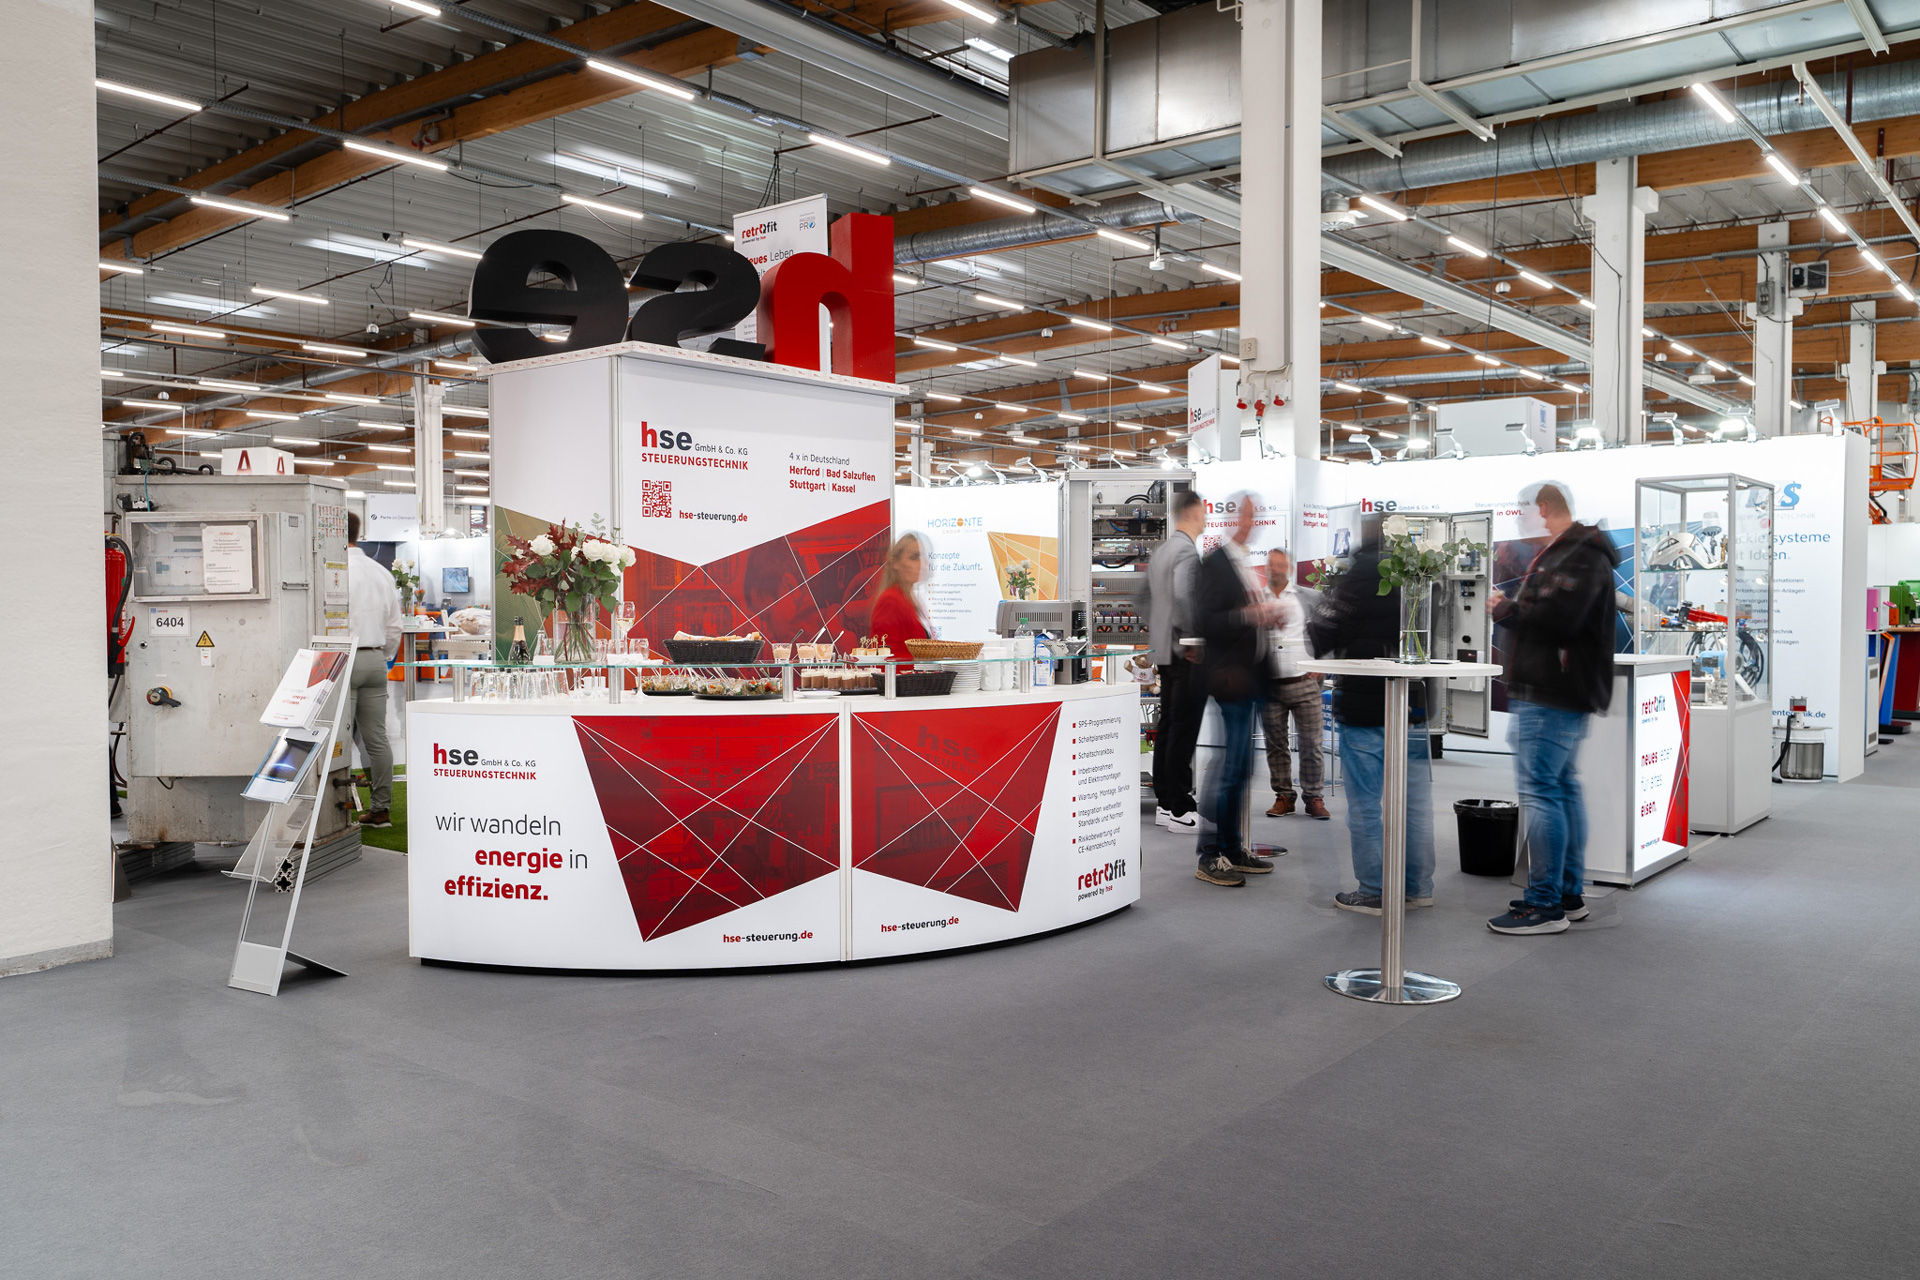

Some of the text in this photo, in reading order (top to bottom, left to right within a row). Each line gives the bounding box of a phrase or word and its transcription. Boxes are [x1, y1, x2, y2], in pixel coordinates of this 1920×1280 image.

[641, 421, 748, 456] hse GmbH & Co. KG
[641, 453, 749, 471] STEUERUNGSTECHNIK
[789, 452, 794, 460] 4
[802, 453, 809, 462] in
[811, 454, 850, 466] Deutschland
[789, 465, 876, 482] Herford Bad Salzuflen
[789, 479, 856, 493] Stuttgart Kassel
[1203, 499, 1237, 514] hse
[1362, 498, 1397, 512] hse
[679, 510, 748, 523] hse-steuerung.de
[928, 552, 960, 560] Konzepte
[928, 562, 983, 571] für die Zukunft.
[156, 617, 184, 627] 6404
[1078, 716, 1122, 728] SPS-Programmierung
[917, 725, 980, 764] hse
[433, 743, 479, 766] hse
[481, 758, 502, 767] GmbH
[1078, 748, 1115, 760] Schaltschrankbau
[1641, 751, 1658, 767] neues
[433, 768, 537, 780] STEUERUNGSTECHNIK
[1078, 806, 1102, 817] Integration
[435, 812, 562, 836] wir wandeln
[475, 847, 588, 874] energie in
[1078, 858, 1126, 891] retrofit
[444, 875, 549, 901] effizienz.
[1078, 884, 1113, 902] powered by hse
[880, 916, 960, 933] hse-steuerung.de
[723, 930, 814, 943] hse-steuerung.de
